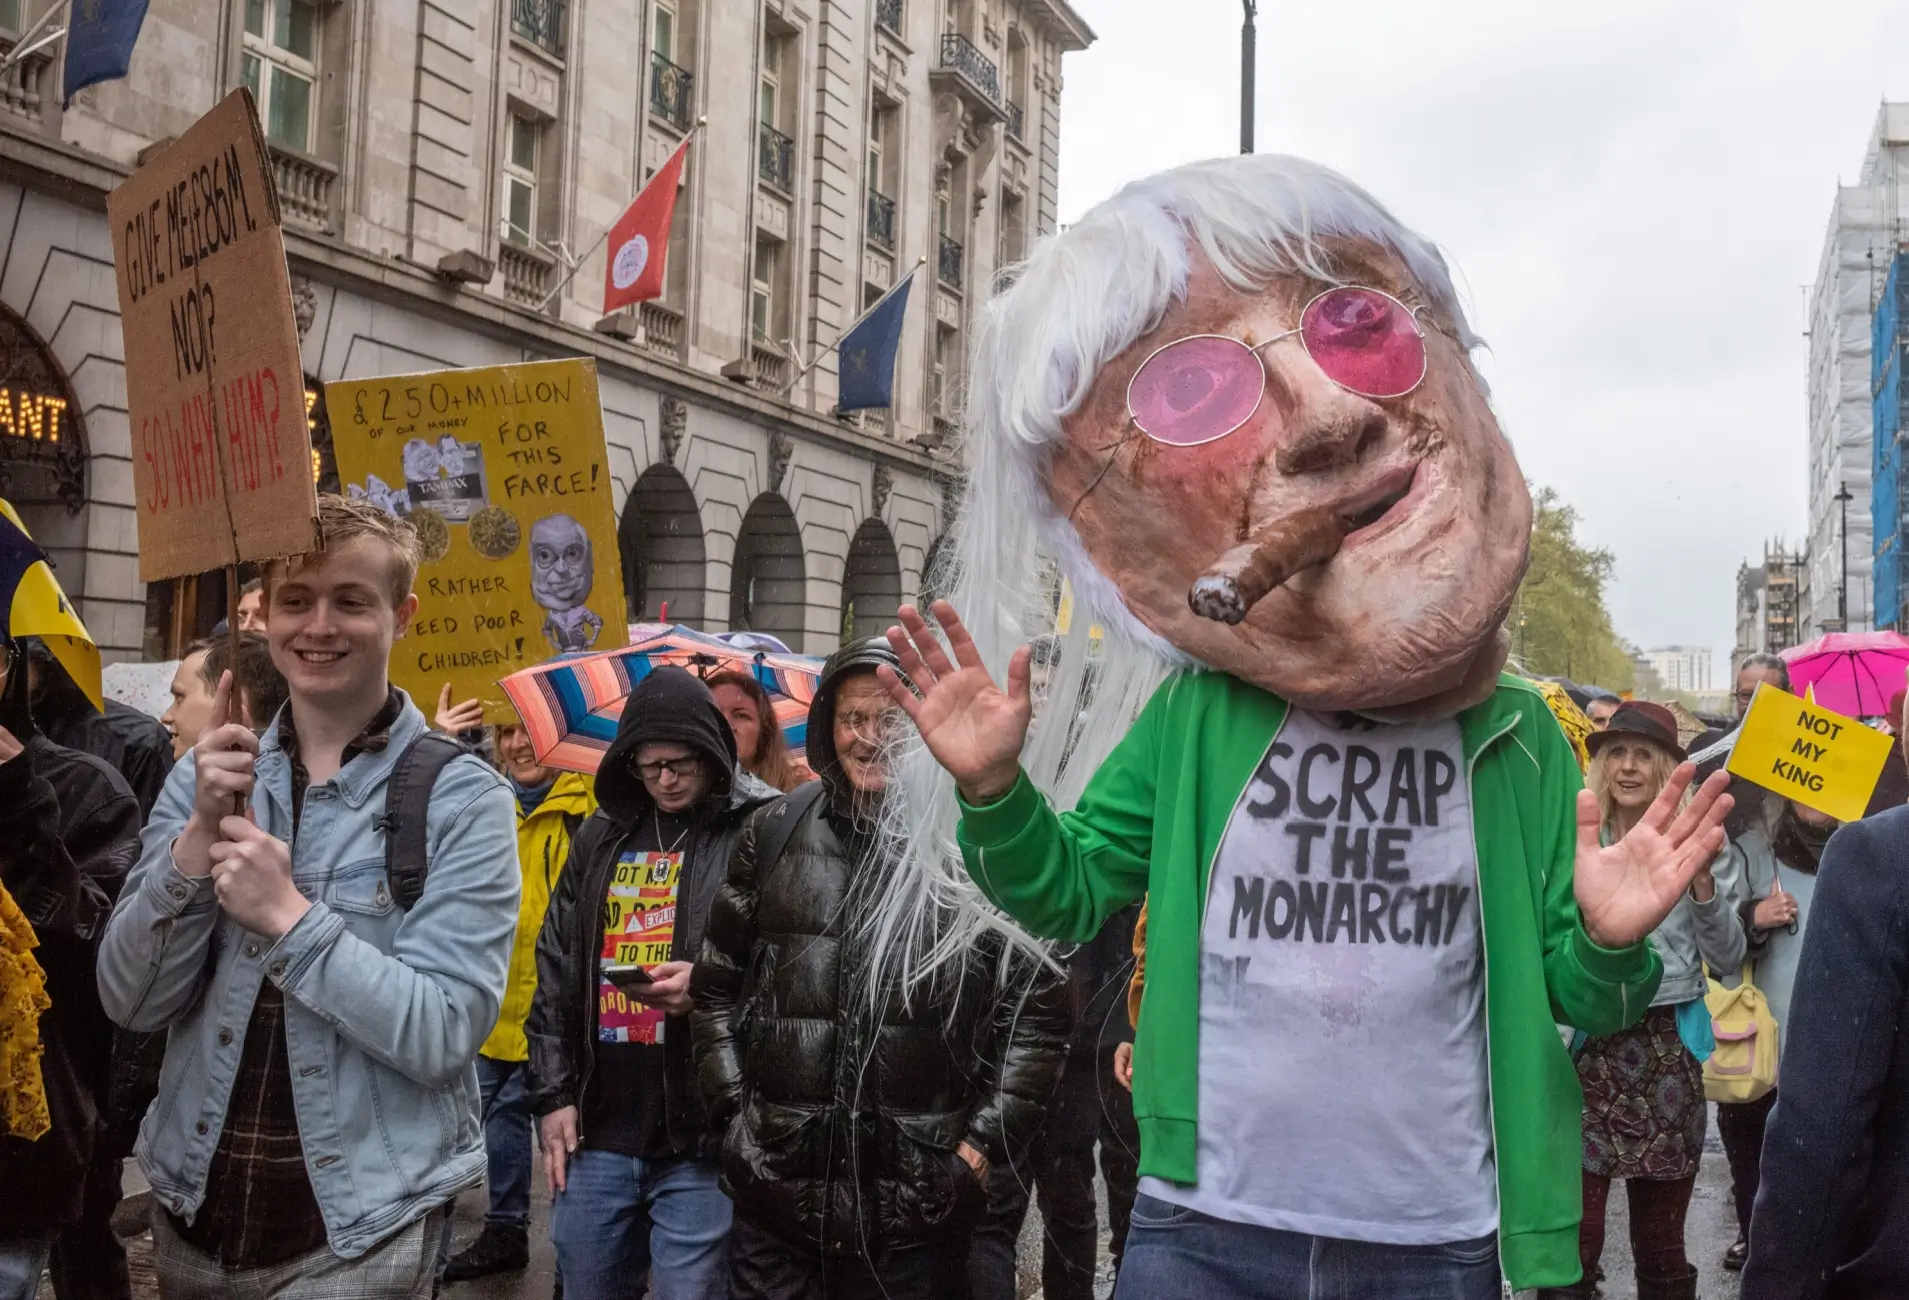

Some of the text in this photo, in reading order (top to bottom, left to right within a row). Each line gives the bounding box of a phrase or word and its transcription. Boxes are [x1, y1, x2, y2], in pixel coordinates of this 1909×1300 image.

[125, 198, 165, 303] GIVE
[166, 181, 193, 278] ME
[170, 282, 217, 382] NO?
[142, 366, 283, 515] SO WHY HIM?
[369, 416, 469, 439] OF OUR MONEY
[498, 420, 551, 446] FOR
[505, 446, 563, 466] THIS
[503, 463, 600, 500] FARCE!
[427, 576, 511, 597] RATHER
[404, 609, 524, 638] EED POOR
[417, 636, 525, 673] CHILDREN!
[1796, 709, 1845, 741] NOT
[1791, 737, 1828, 763] MY
[1246, 742, 1457, 827] SCRAP
[1771, 757, 1825, 793] KING
[1283, 821, 1413, 883] THE
[1228, 875, 1471, 948] MONARCHY
[620, 944, 639, 963] TO
